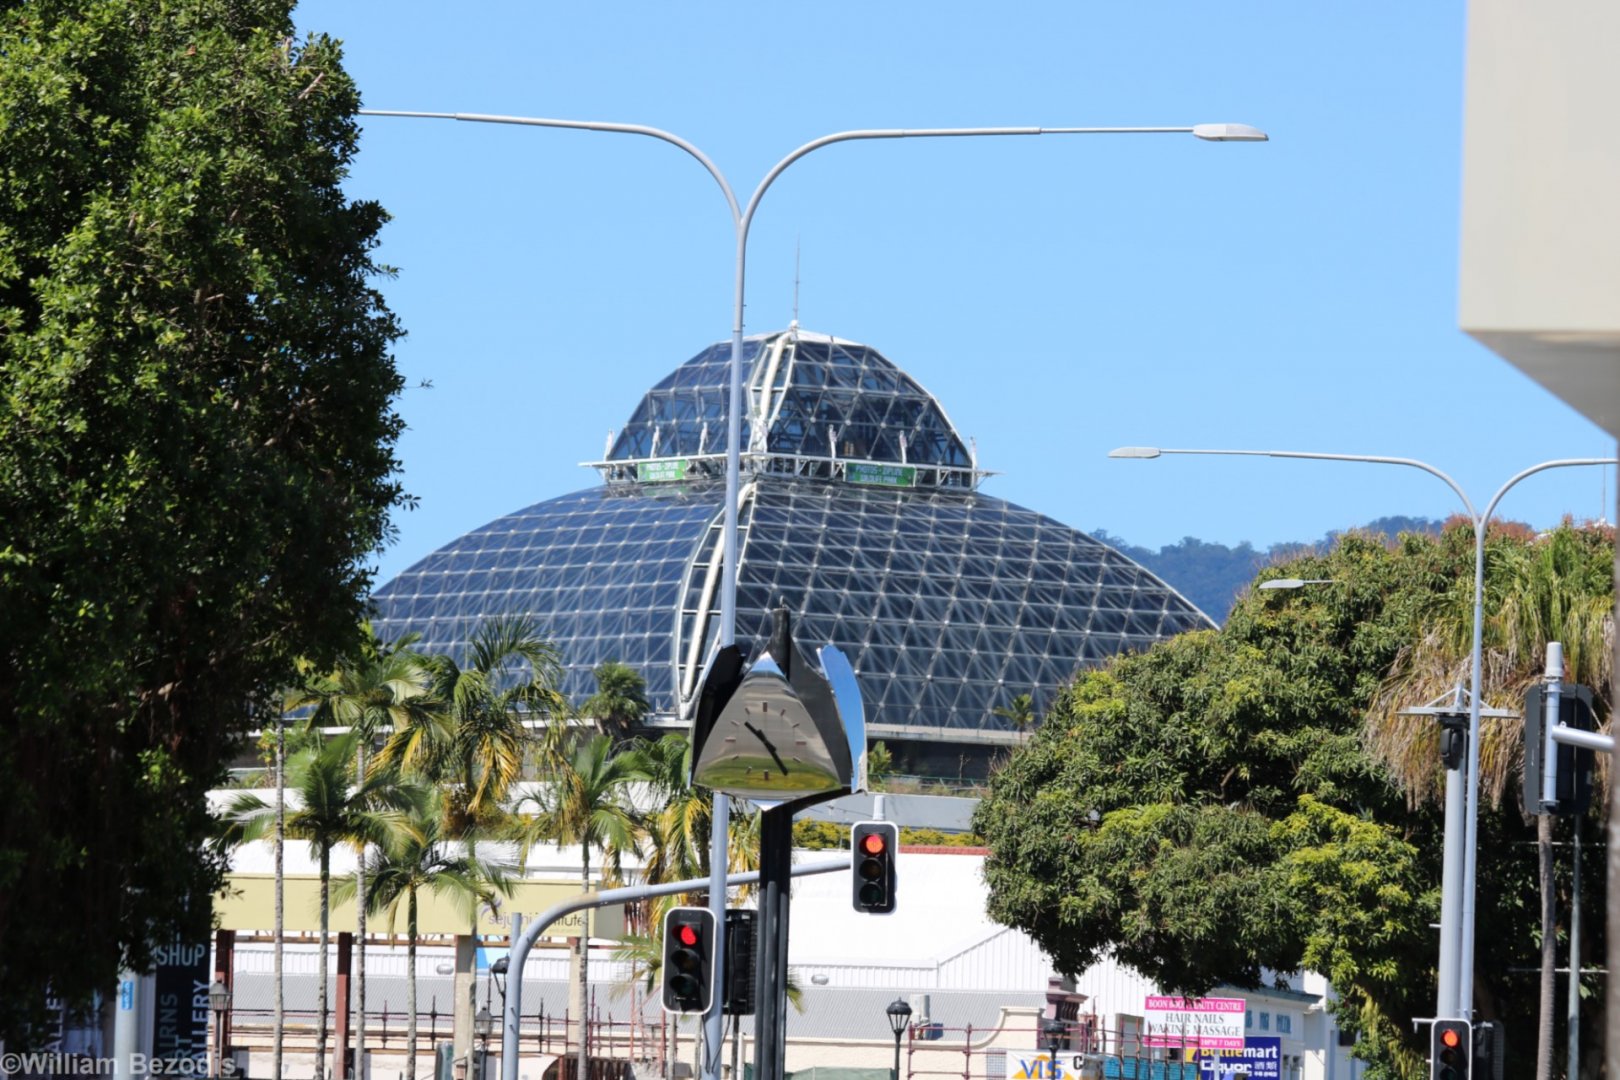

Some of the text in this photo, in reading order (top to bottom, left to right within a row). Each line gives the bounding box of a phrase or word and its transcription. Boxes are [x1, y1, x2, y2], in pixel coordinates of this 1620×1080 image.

[1165, 1012, 1224, 1024] HAIR NAILS
[1224, 1039, 1241, 1047] DAYS
